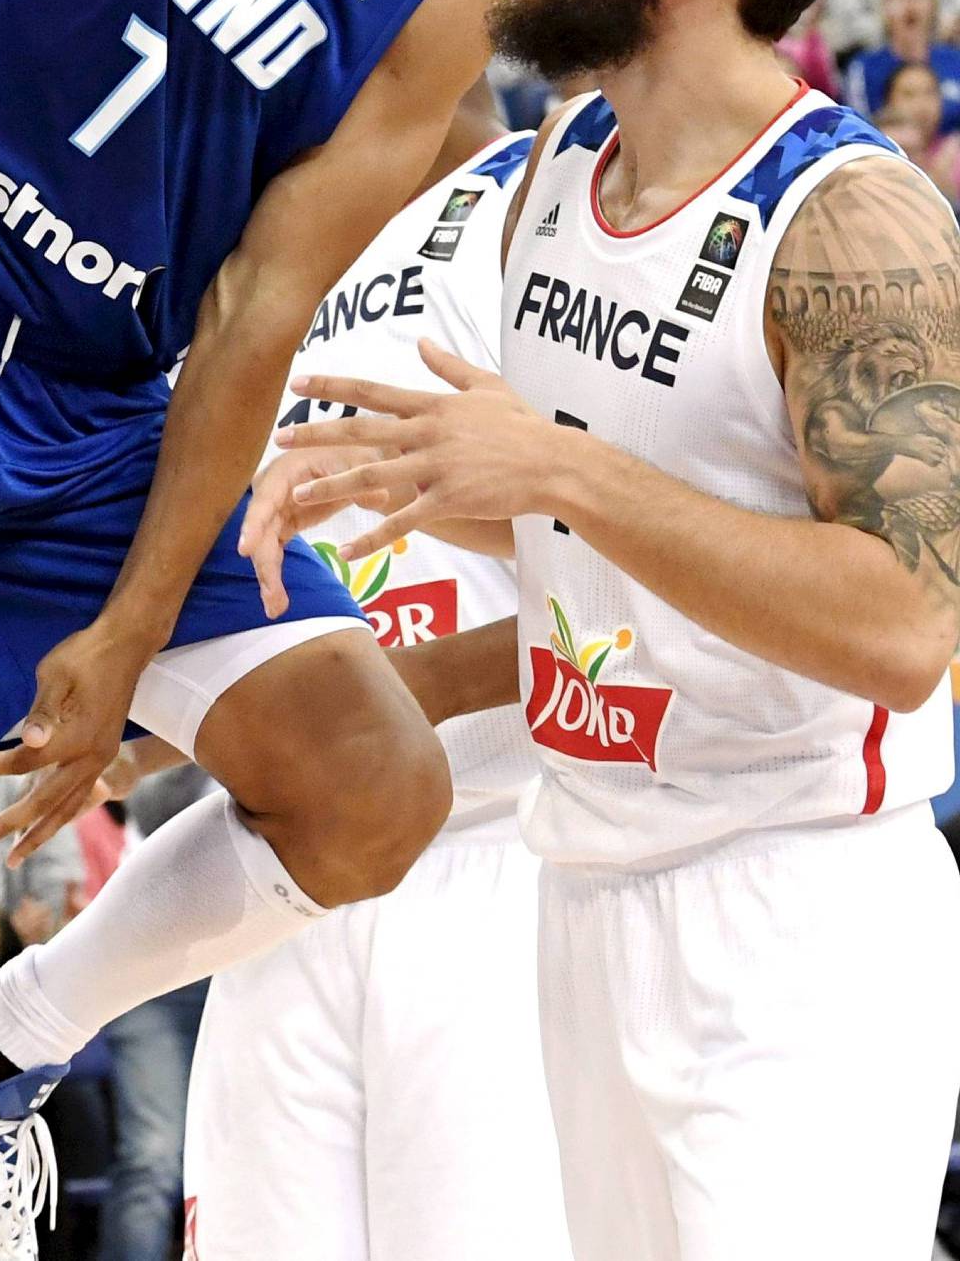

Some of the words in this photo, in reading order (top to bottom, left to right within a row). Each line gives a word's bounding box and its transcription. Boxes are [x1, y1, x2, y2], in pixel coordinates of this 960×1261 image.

[68, 12, 168, 158] 7
[297, 265, 425, 353] ANCE
[513, 271, 691, 389] FRANCE
[691, 271, 724, 297] FIBA
